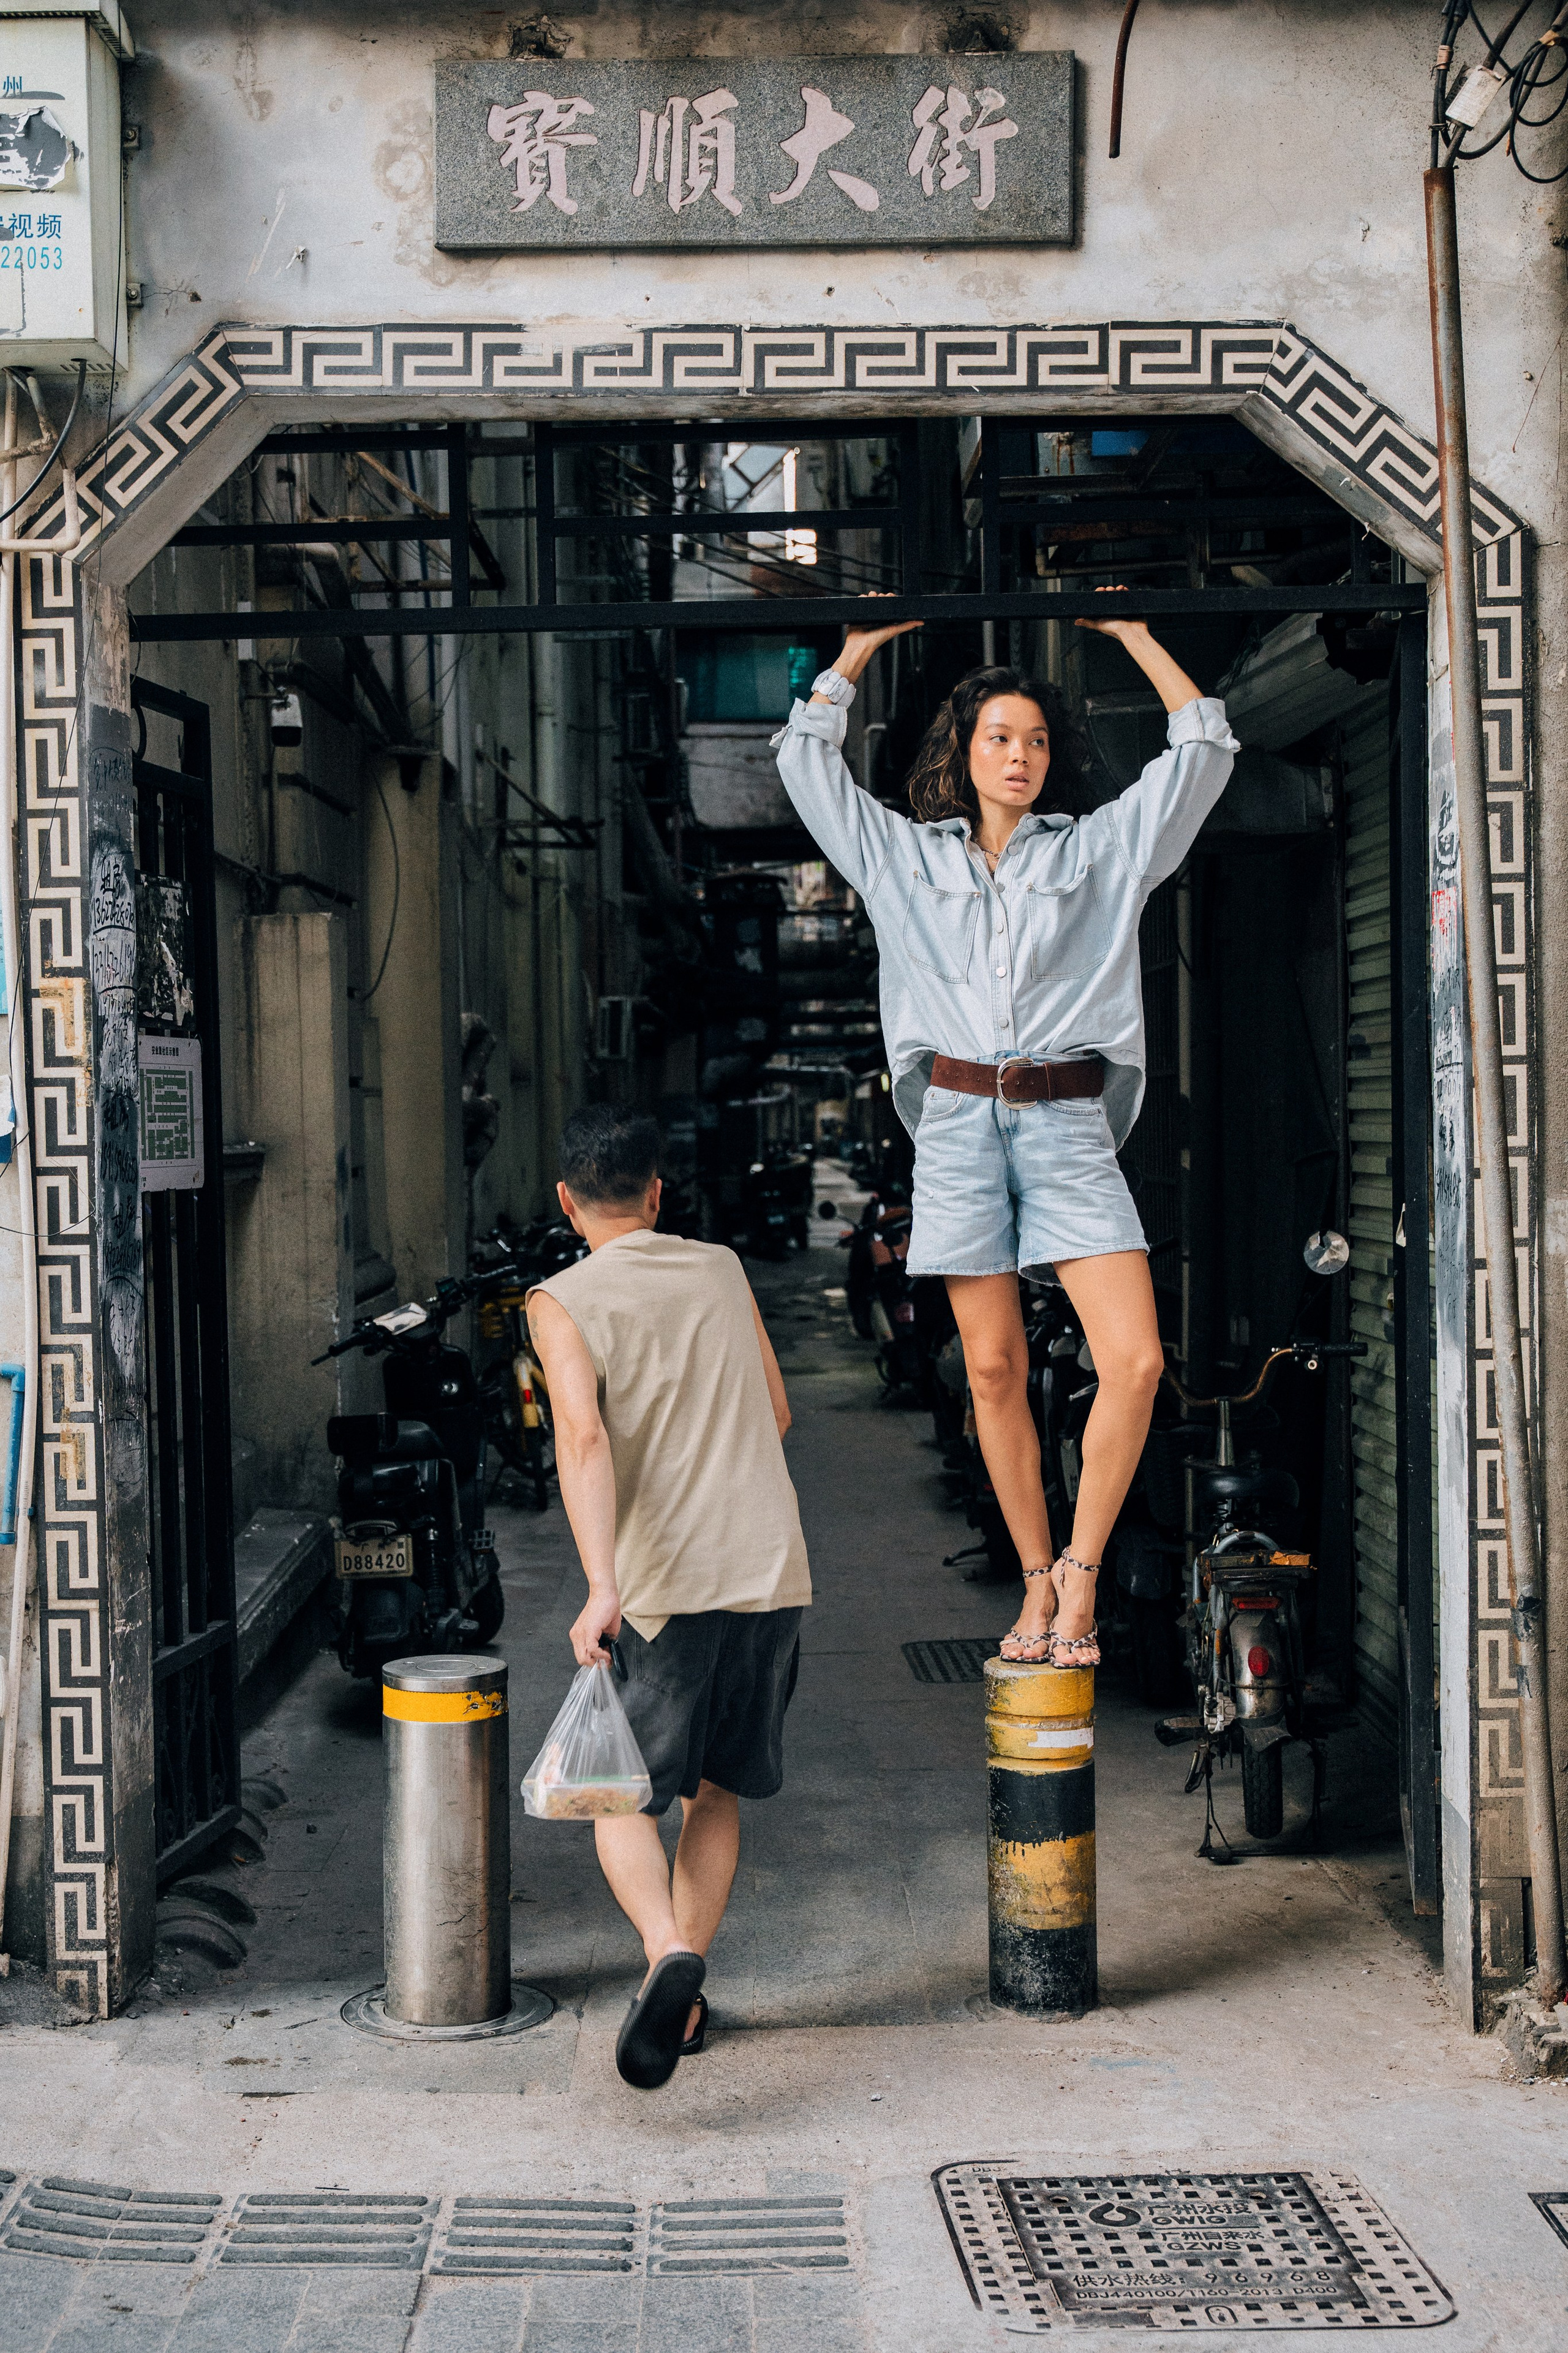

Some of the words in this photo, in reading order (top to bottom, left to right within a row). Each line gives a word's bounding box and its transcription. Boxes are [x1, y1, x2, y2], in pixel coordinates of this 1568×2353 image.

[487, 85, 1019, 216] 寶順大街
[0, 213, 62, 240] 视频
[1, 246, 62, 270] 22053
[343, 1552, 405, 1571] D88420
[1147, 2203, 1252, 2216] 广州水投
[1161, 2230, 1265, 2241] 广州自来水
[1167, 2242, 1242, 2251] GZWS
